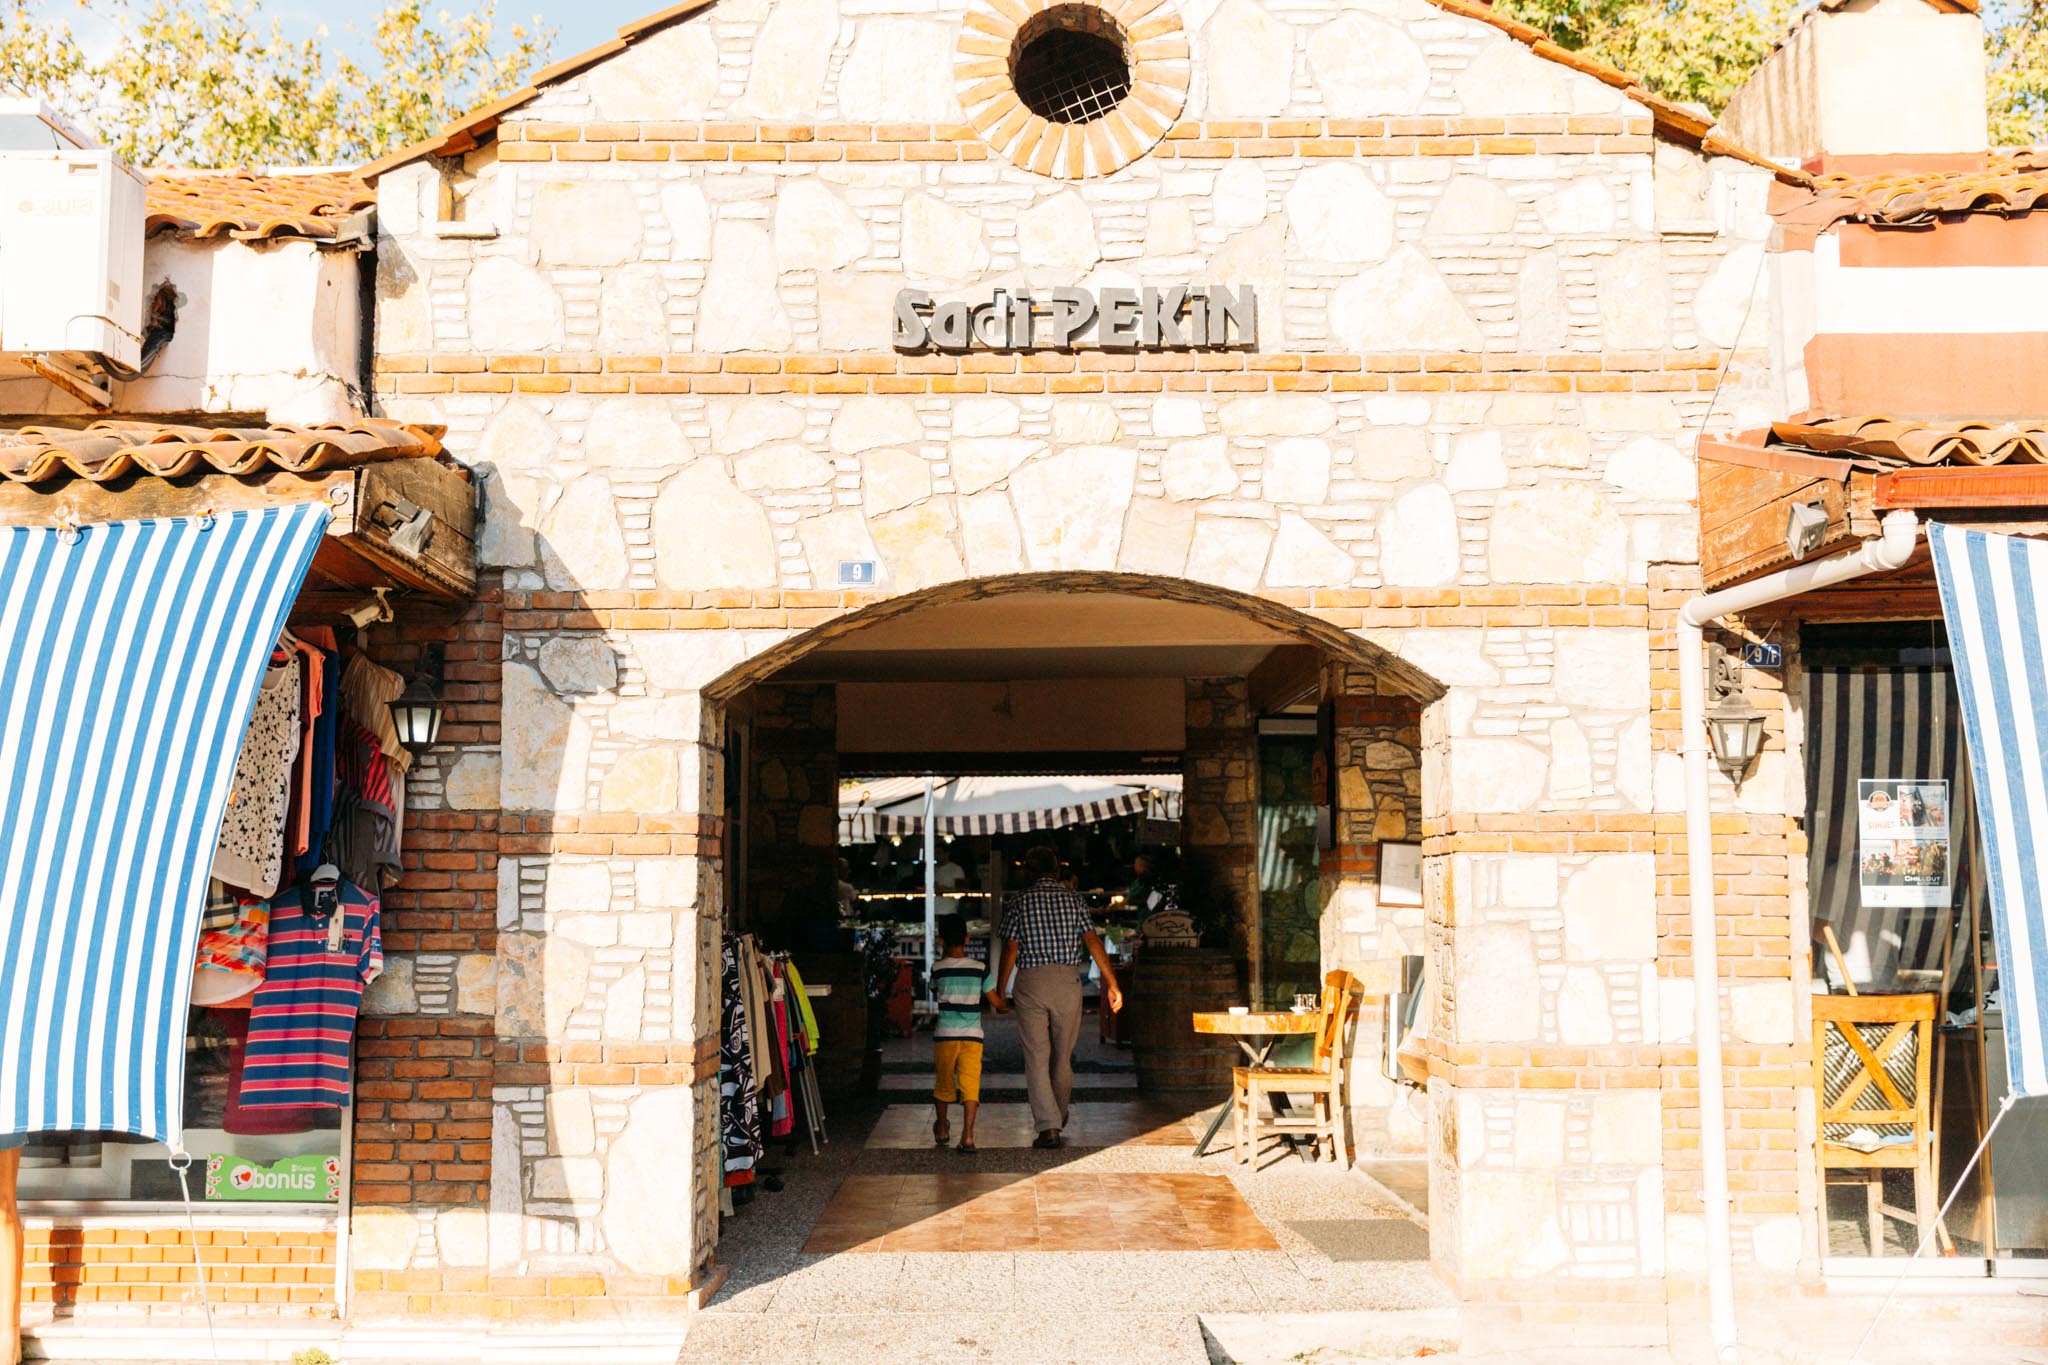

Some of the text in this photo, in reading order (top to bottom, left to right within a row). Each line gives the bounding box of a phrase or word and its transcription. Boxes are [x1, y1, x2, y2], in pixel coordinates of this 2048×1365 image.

[893, 286, 1032, 349] Sadi
[853, 563, 862, 580] 9
[252, 1167, 316, 1190] bonus
